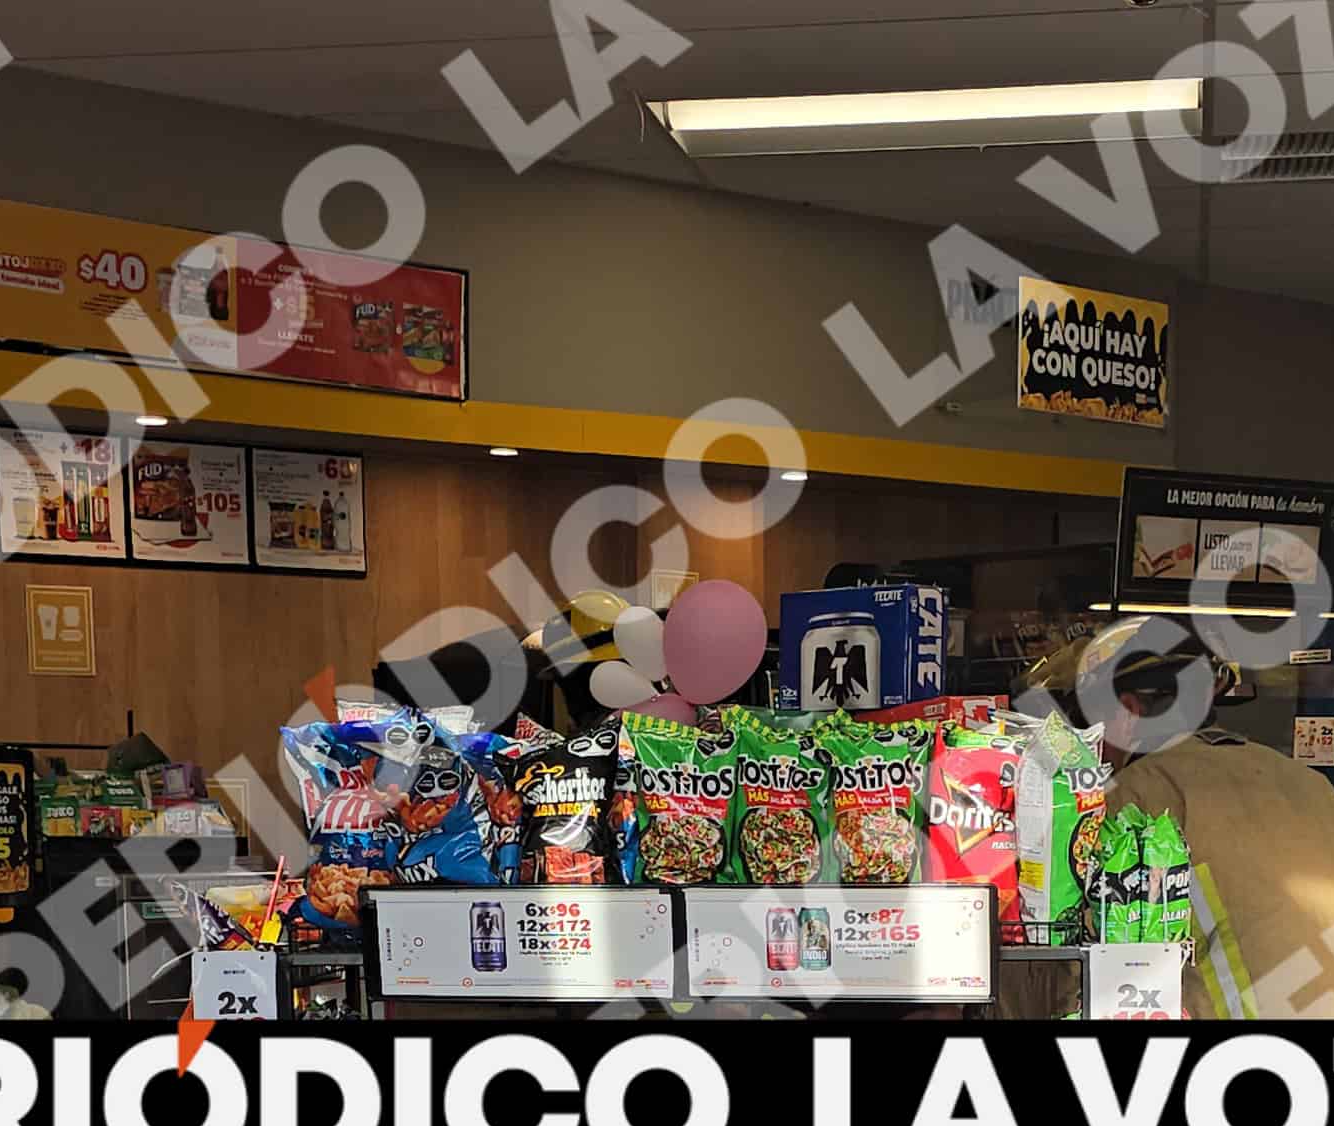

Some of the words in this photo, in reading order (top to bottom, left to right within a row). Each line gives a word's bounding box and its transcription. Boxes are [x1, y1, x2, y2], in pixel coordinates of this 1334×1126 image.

[79, 252, 147, 291] $40
[1042, 320, 1102, 352] ¡AQUÍ
[1105, 328, 1148, 358] HAY
[1031, 354, 1077, 378] CON
[1081, 358, 1157, 389] QUESO!
[136, 462, 164, 481] FUD
[1166, 487, 1180, 506] LA
[1181, 489, 1214, 508] MEJOR
[1214, 490, 1250, 510] OPCIÓN
[1251, 494, 1277, 512] PARA
[1203, 533, 1230, 551] LISTO
[1211, 554, 1245, 573] LLEVAR
[874, 589, 904, 603] TECATE
[929, 796, 1017, 833] Doritos
[525, 902, 581, 918] 6x$96
[843, 908, 904, 925] 6x$87
[517, 918, 591, 934] 12x$172
[834, 924, 921, 942] 12x$165
[518, 937, 592, 951] 18x$274
[217, 991, 258, 1016] 2x
[1117, 984, 1161, 1009] 2x
